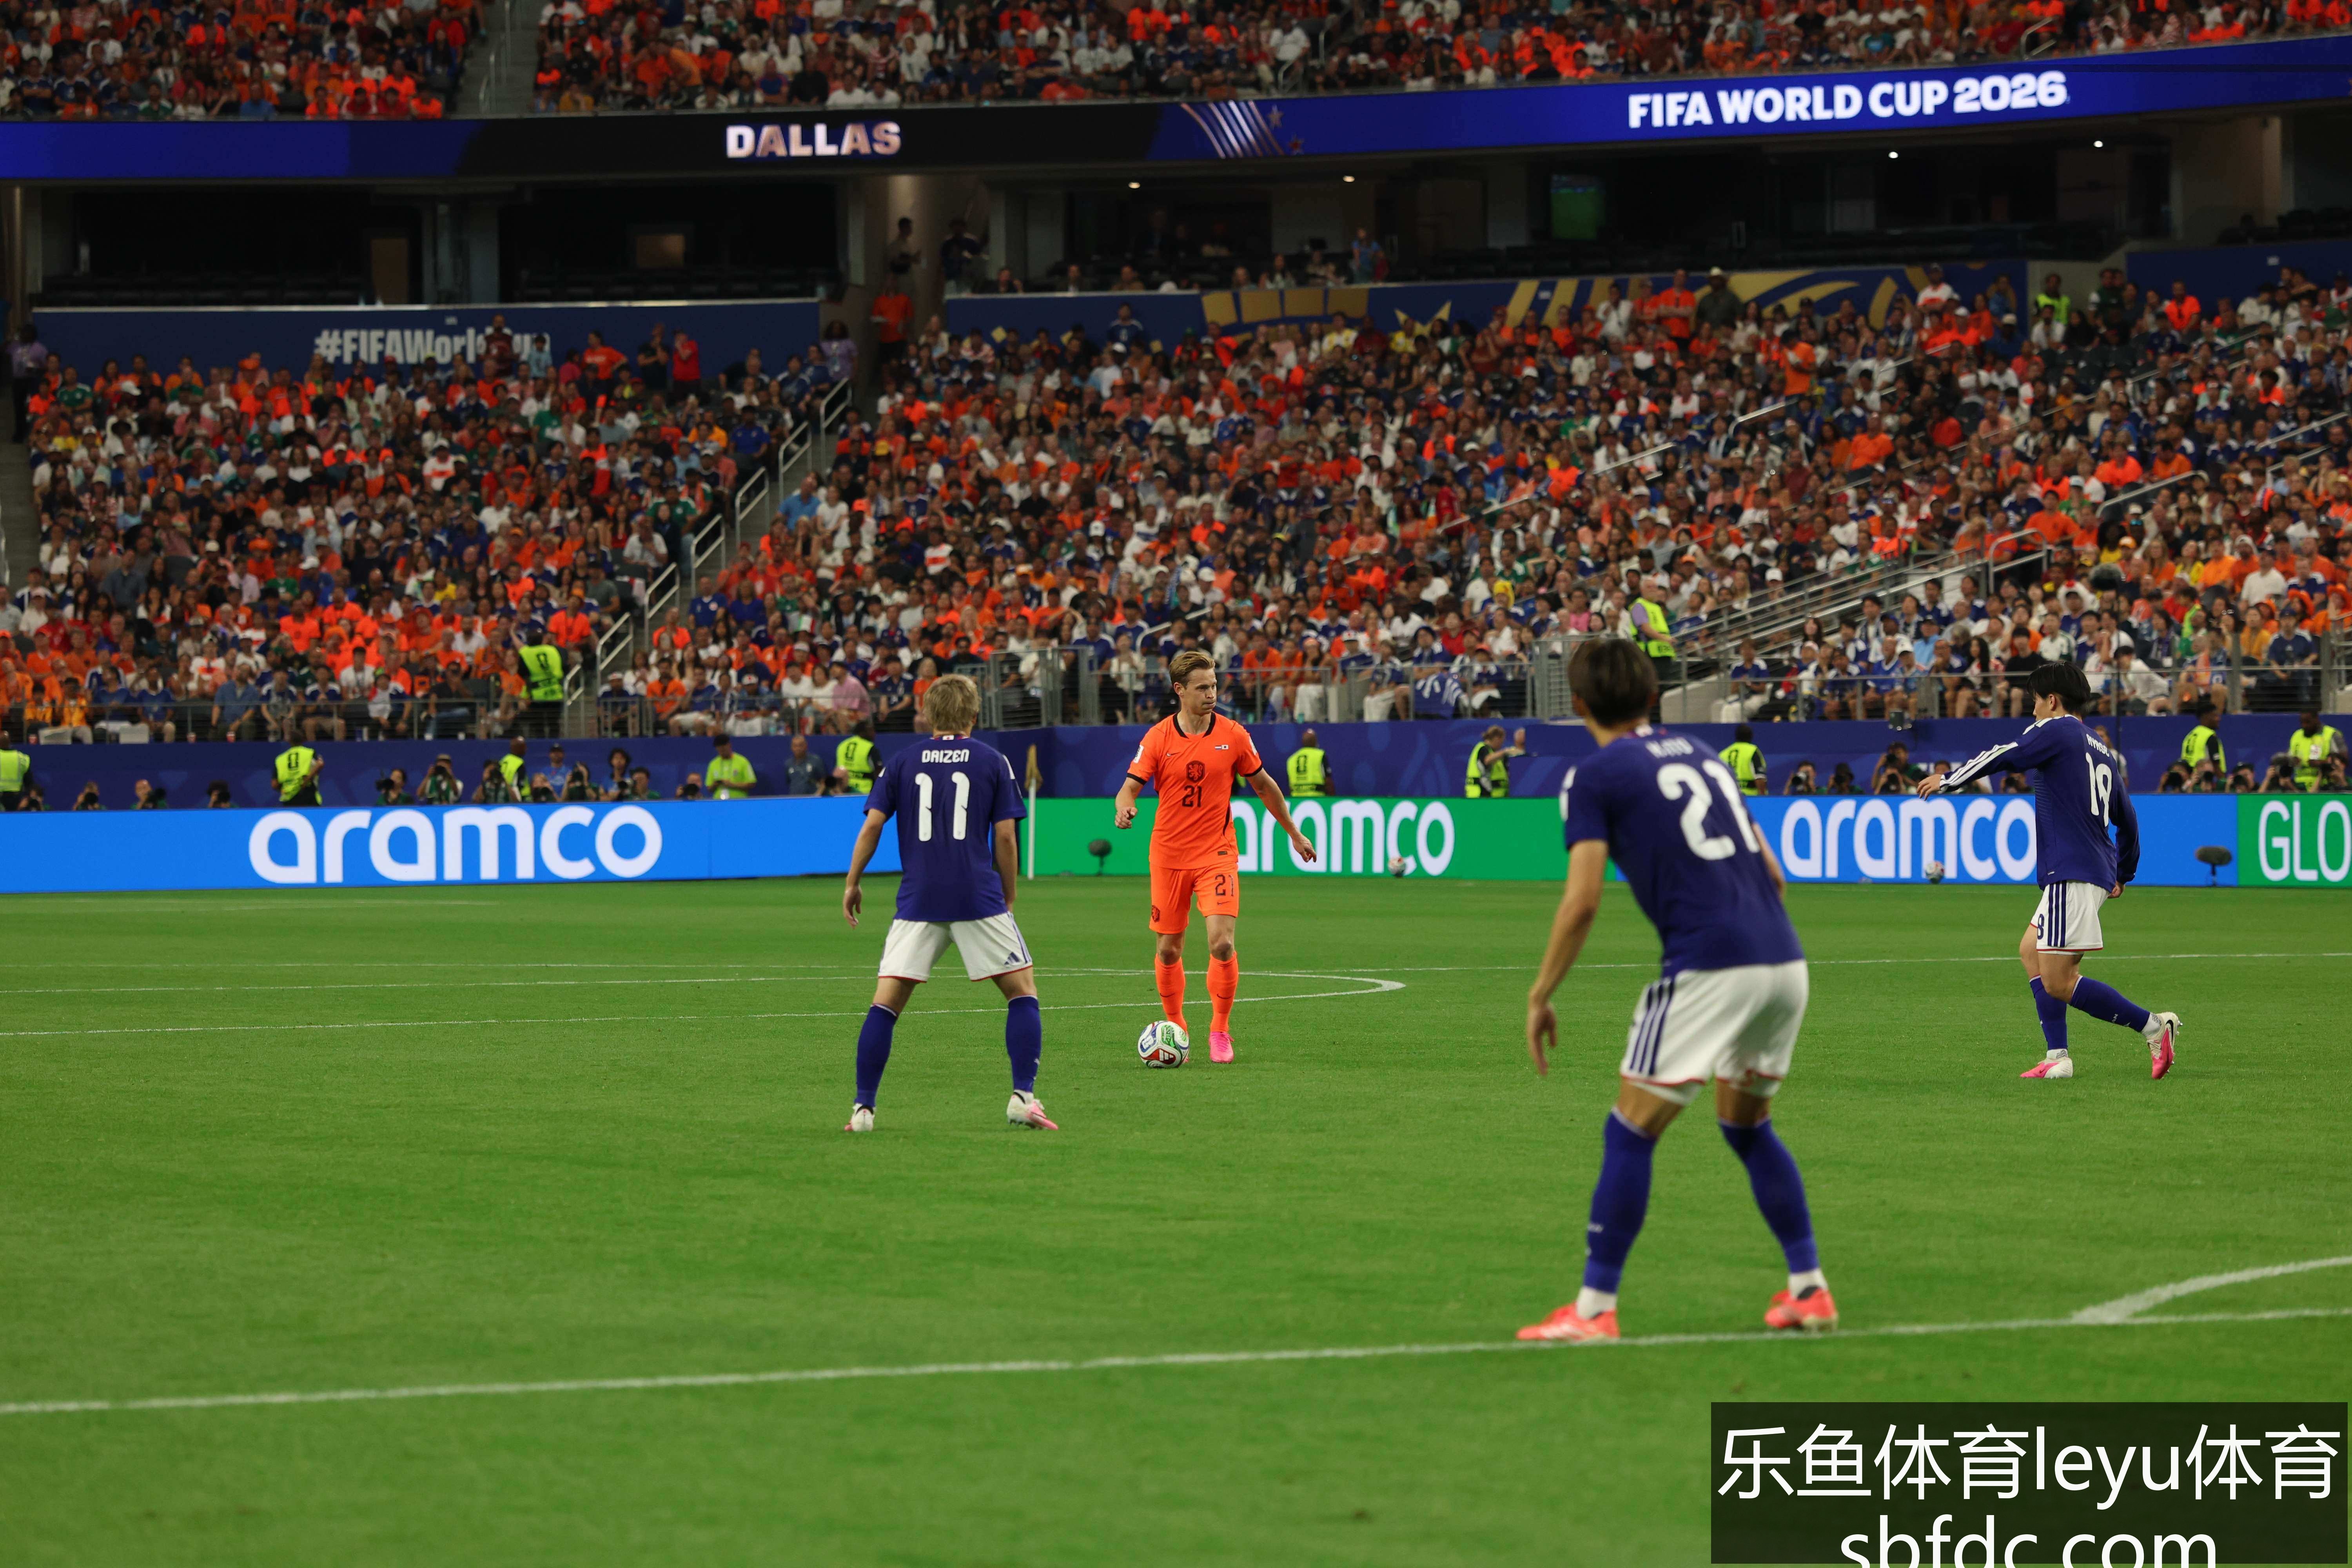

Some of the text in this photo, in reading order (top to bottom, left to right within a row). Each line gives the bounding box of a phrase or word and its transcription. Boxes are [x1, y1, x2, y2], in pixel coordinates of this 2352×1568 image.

[1628, 71, 2067, 128] FIFA WORLD CUP 2026
[726, 122, 901, 158] DALLAS
[922, 749, 970, 763] DAIZEN
[2086, 733, 2110, 757] AYASE
[915, 771, 970, 842] 11
[1182, 785, 1202, 808] 21
[1657, 759, 1760, 860] 21
[249, 806, 662, 883] aramco
[1781, 798, 2037, 880] aramco
[2259, 800, 2352, 882] GLO
[1215, 874, 1234, 897] 21
